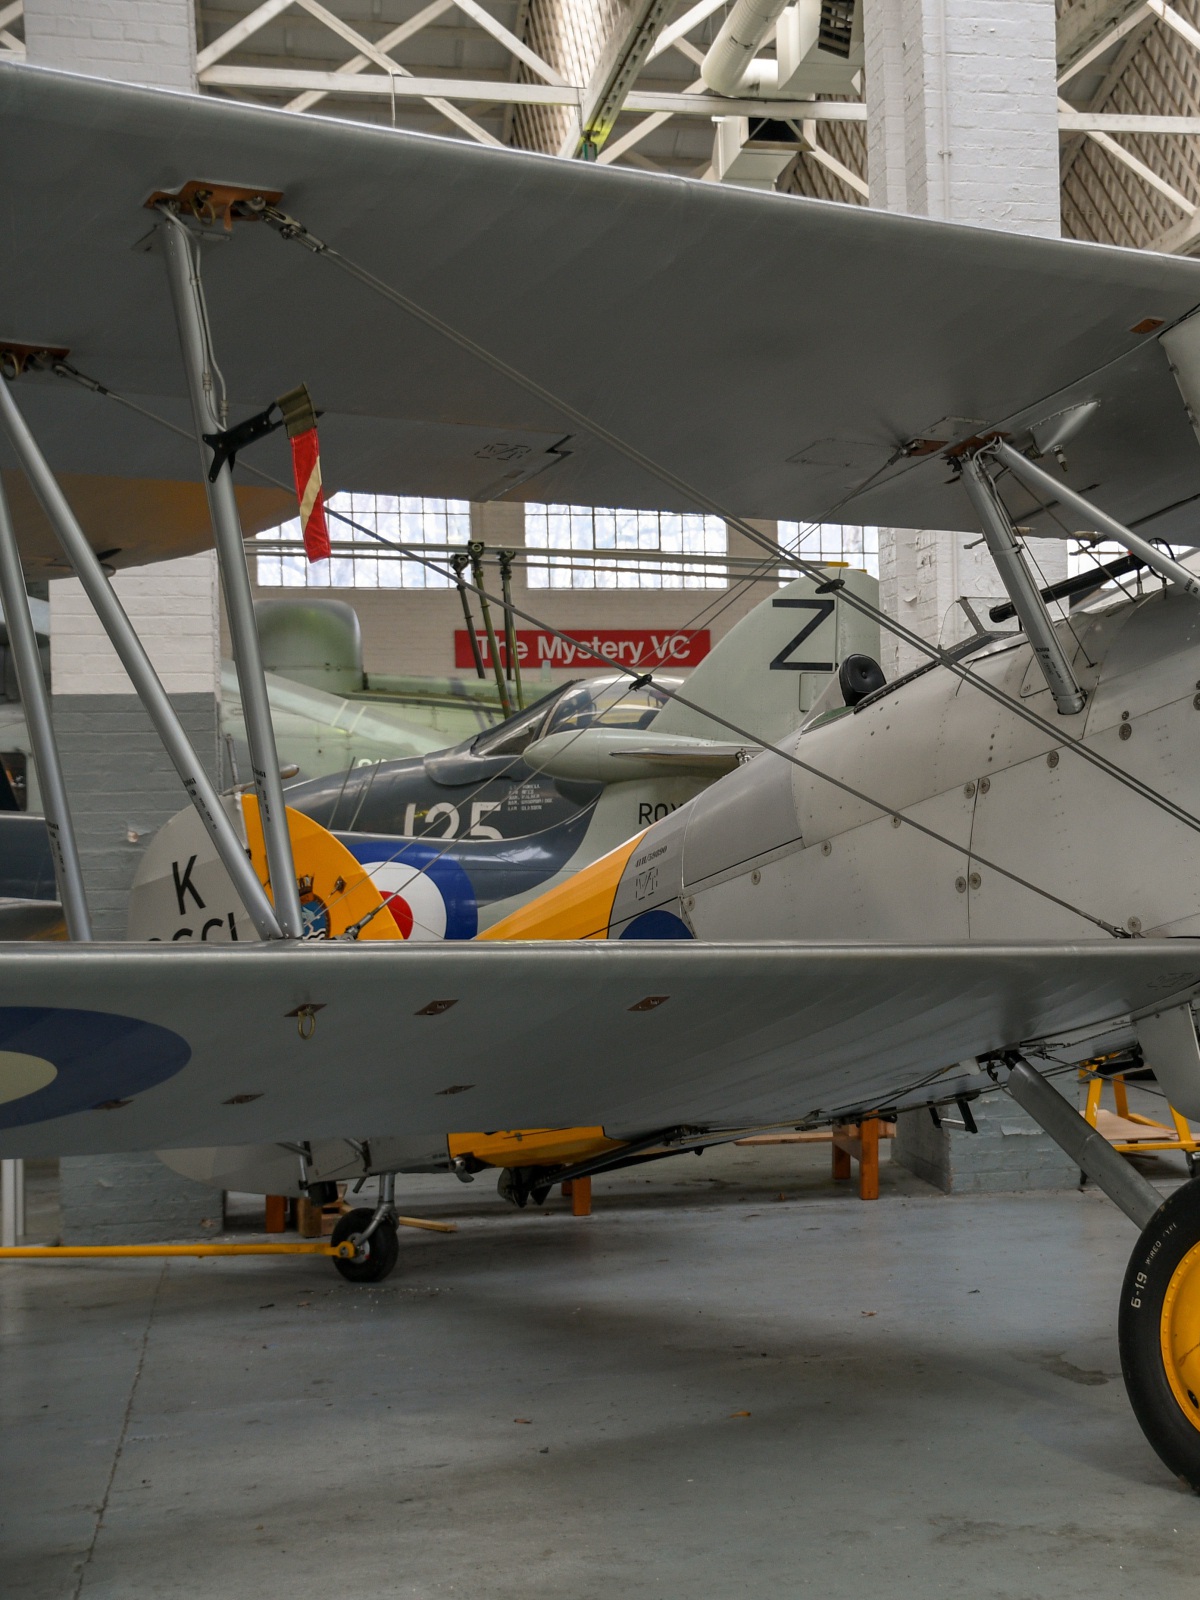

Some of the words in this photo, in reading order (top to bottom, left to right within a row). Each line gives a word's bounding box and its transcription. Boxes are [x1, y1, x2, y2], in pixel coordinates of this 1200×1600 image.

[476, 635, 529, 660] The
[537, 635, 645, 664] Mystery
[650, 635, 691, 660] VC
[769, 598, 835, 672] Z
[172, 854, 206, 916] K
[1131, 1271, 1148, 1309] 6-19
